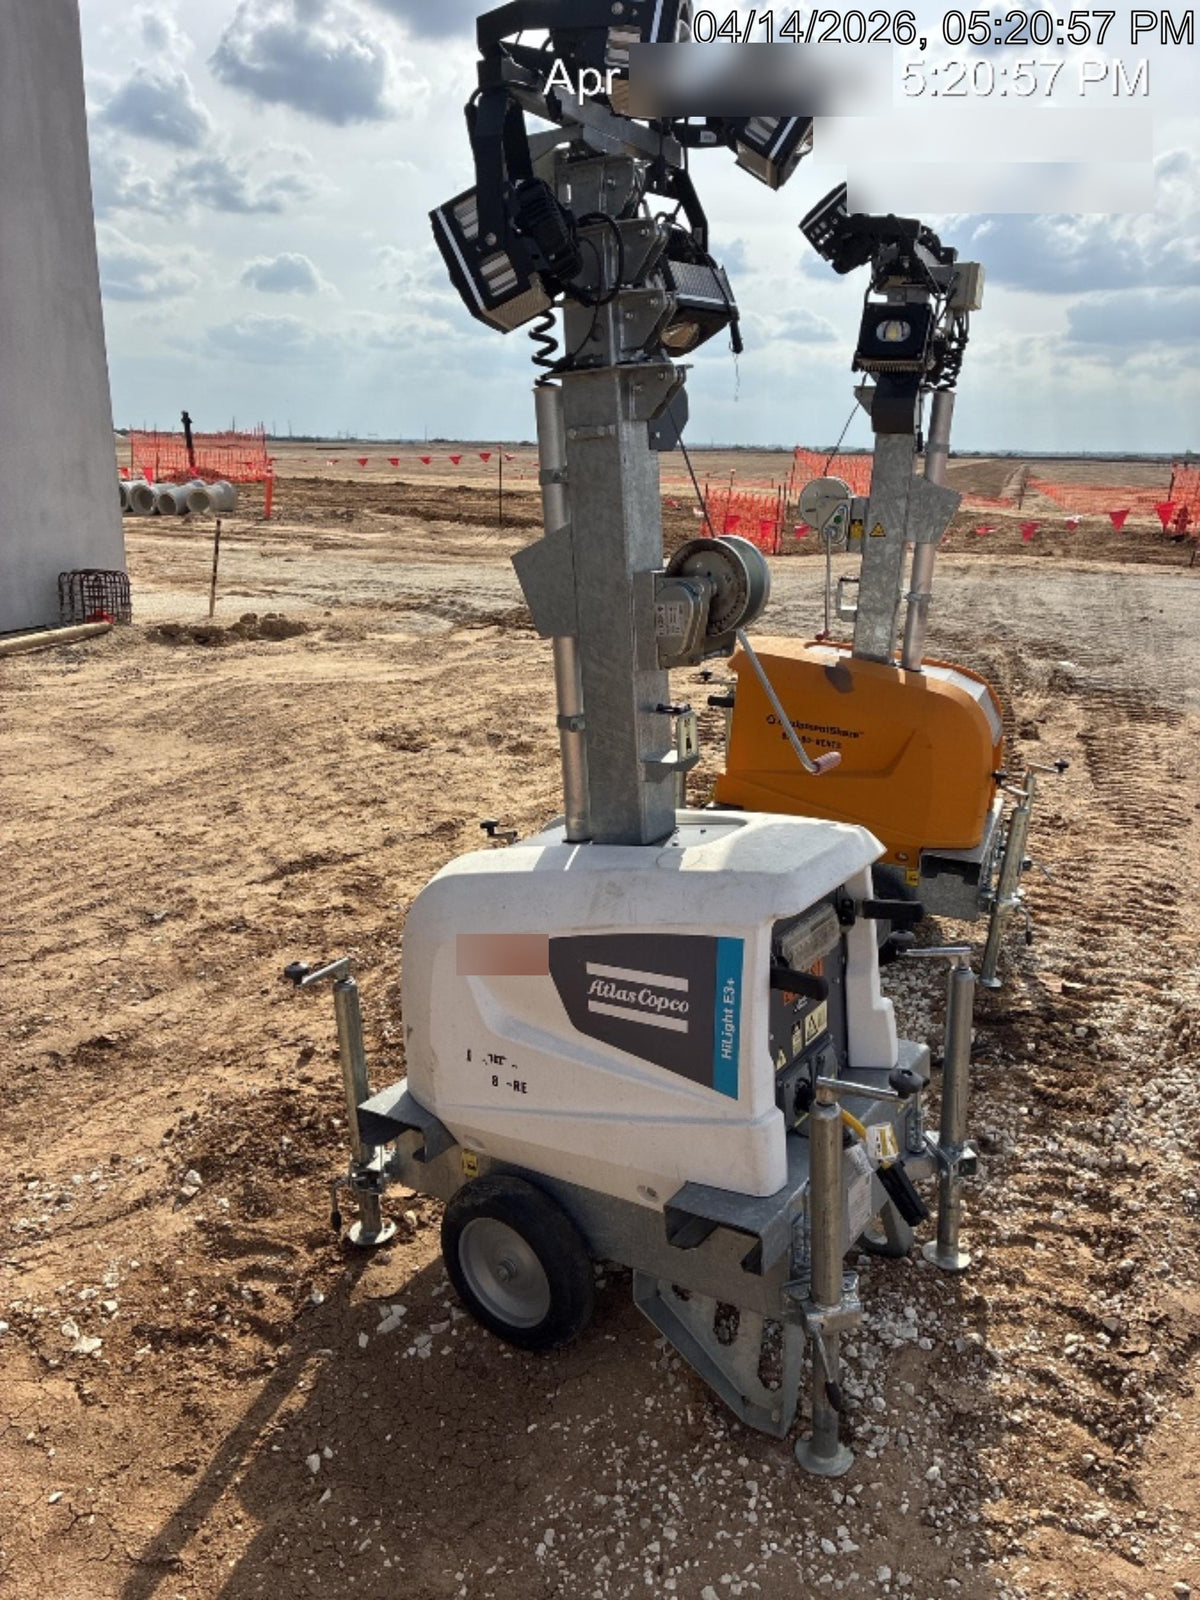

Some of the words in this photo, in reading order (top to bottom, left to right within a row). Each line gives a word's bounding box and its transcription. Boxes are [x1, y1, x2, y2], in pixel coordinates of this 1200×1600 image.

[588, 979, 638, 1004] Atlas
[638, 988, 690, 1013] Copco
[723, 978, 736, 1005] E3+
[721, 1009, 737, 1060] HiLight
